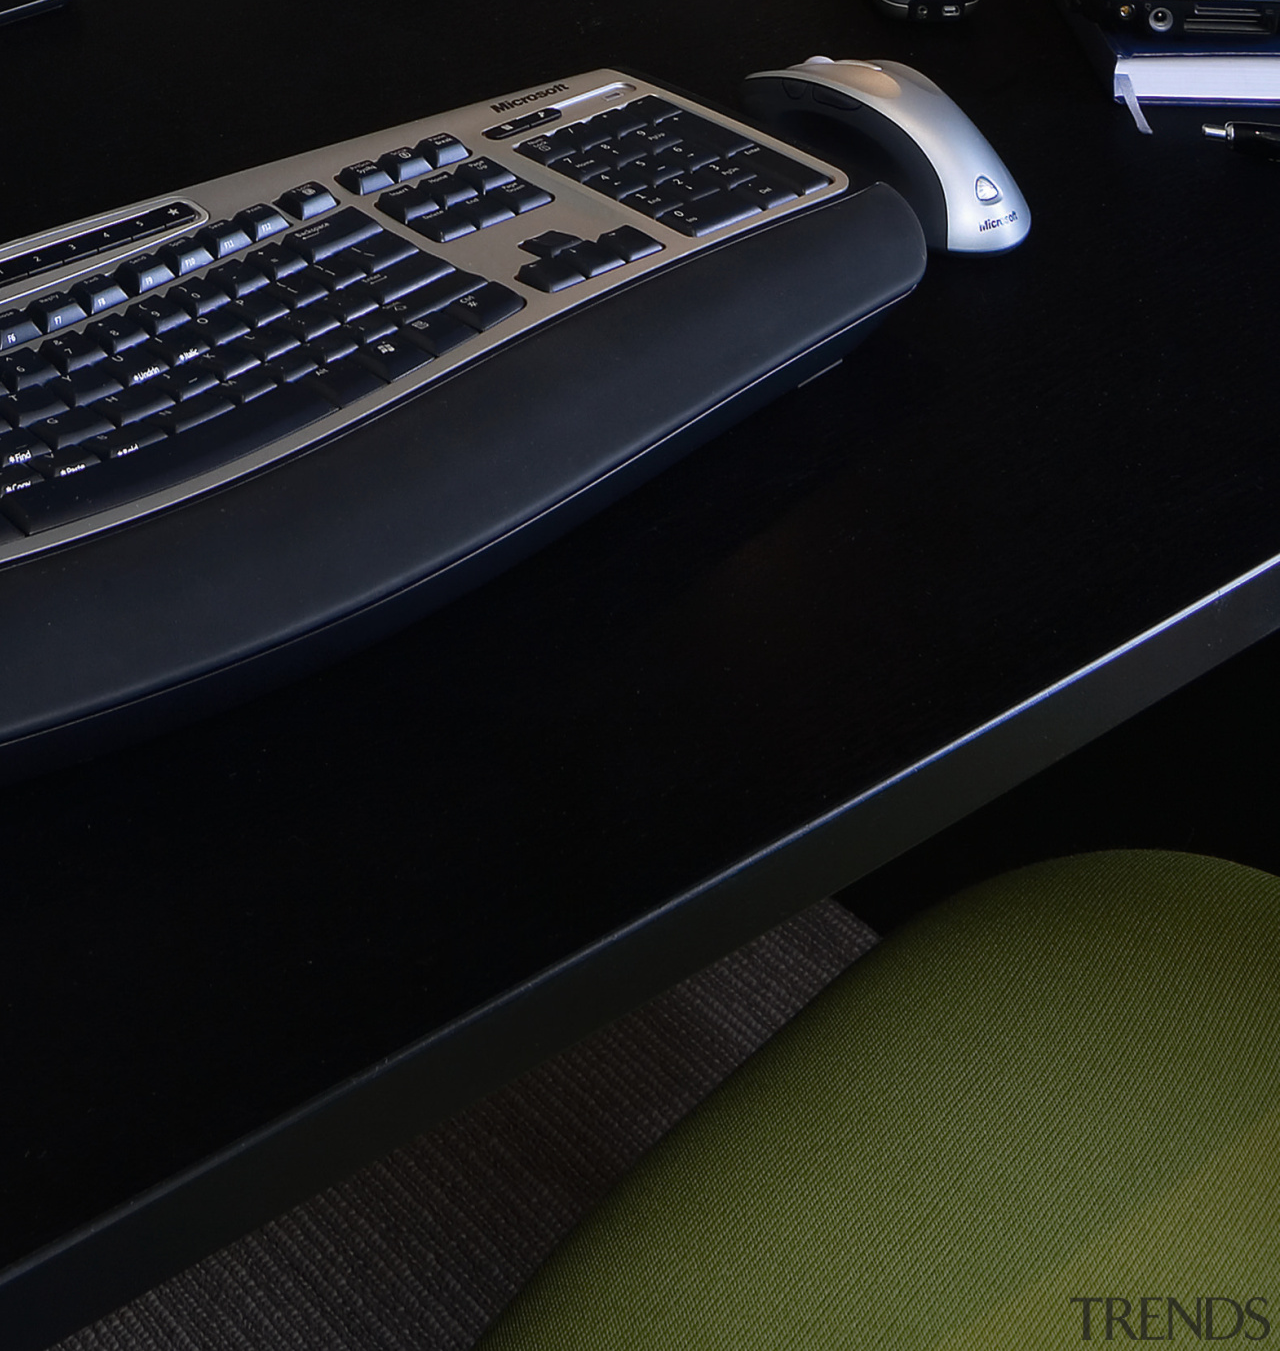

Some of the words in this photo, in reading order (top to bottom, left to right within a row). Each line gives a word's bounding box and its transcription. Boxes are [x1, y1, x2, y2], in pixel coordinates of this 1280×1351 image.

[489, 83, 570, 114] Microsoft
[261, 222, 272, 232] F12
[224, 239, 234, 250] F11
[185, 257, 195, 267] F10
[146, 276, 153, 285] F9
[54, 315, 62, 325] F7
[7, 333, 16, 343] F6
